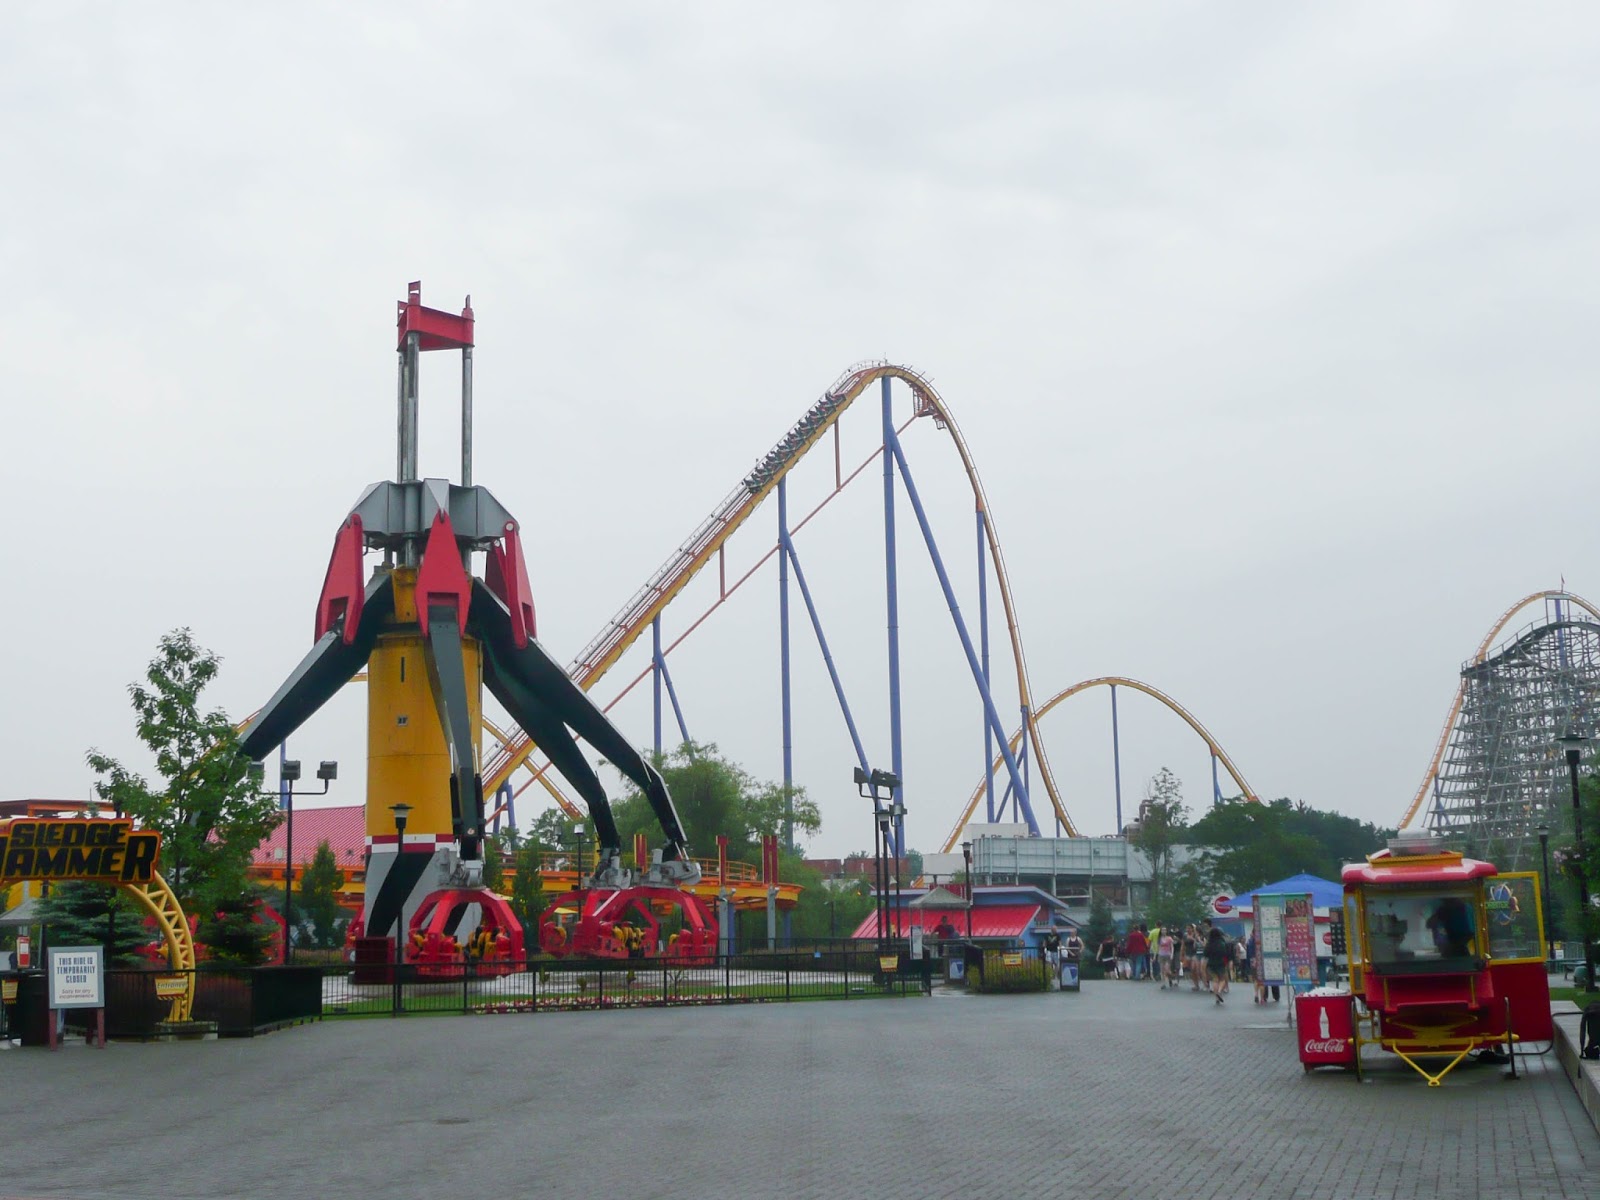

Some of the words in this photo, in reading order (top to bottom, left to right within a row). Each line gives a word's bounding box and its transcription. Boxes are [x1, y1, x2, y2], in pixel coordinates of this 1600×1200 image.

[10, 823, 130, 847] SLEDGE
[0, 835, 158, 881] AMMER
[59, 957, 72, 965] THIS
[73, 957, 86, 965] RIDE
[87, 956, 93, 964] IS
[57, 966, 96, 974] TEMPORARILY
[66, 975, 87, 983] CLOSED
[1305, 1038, 1345, 1053] Coca-Cola
